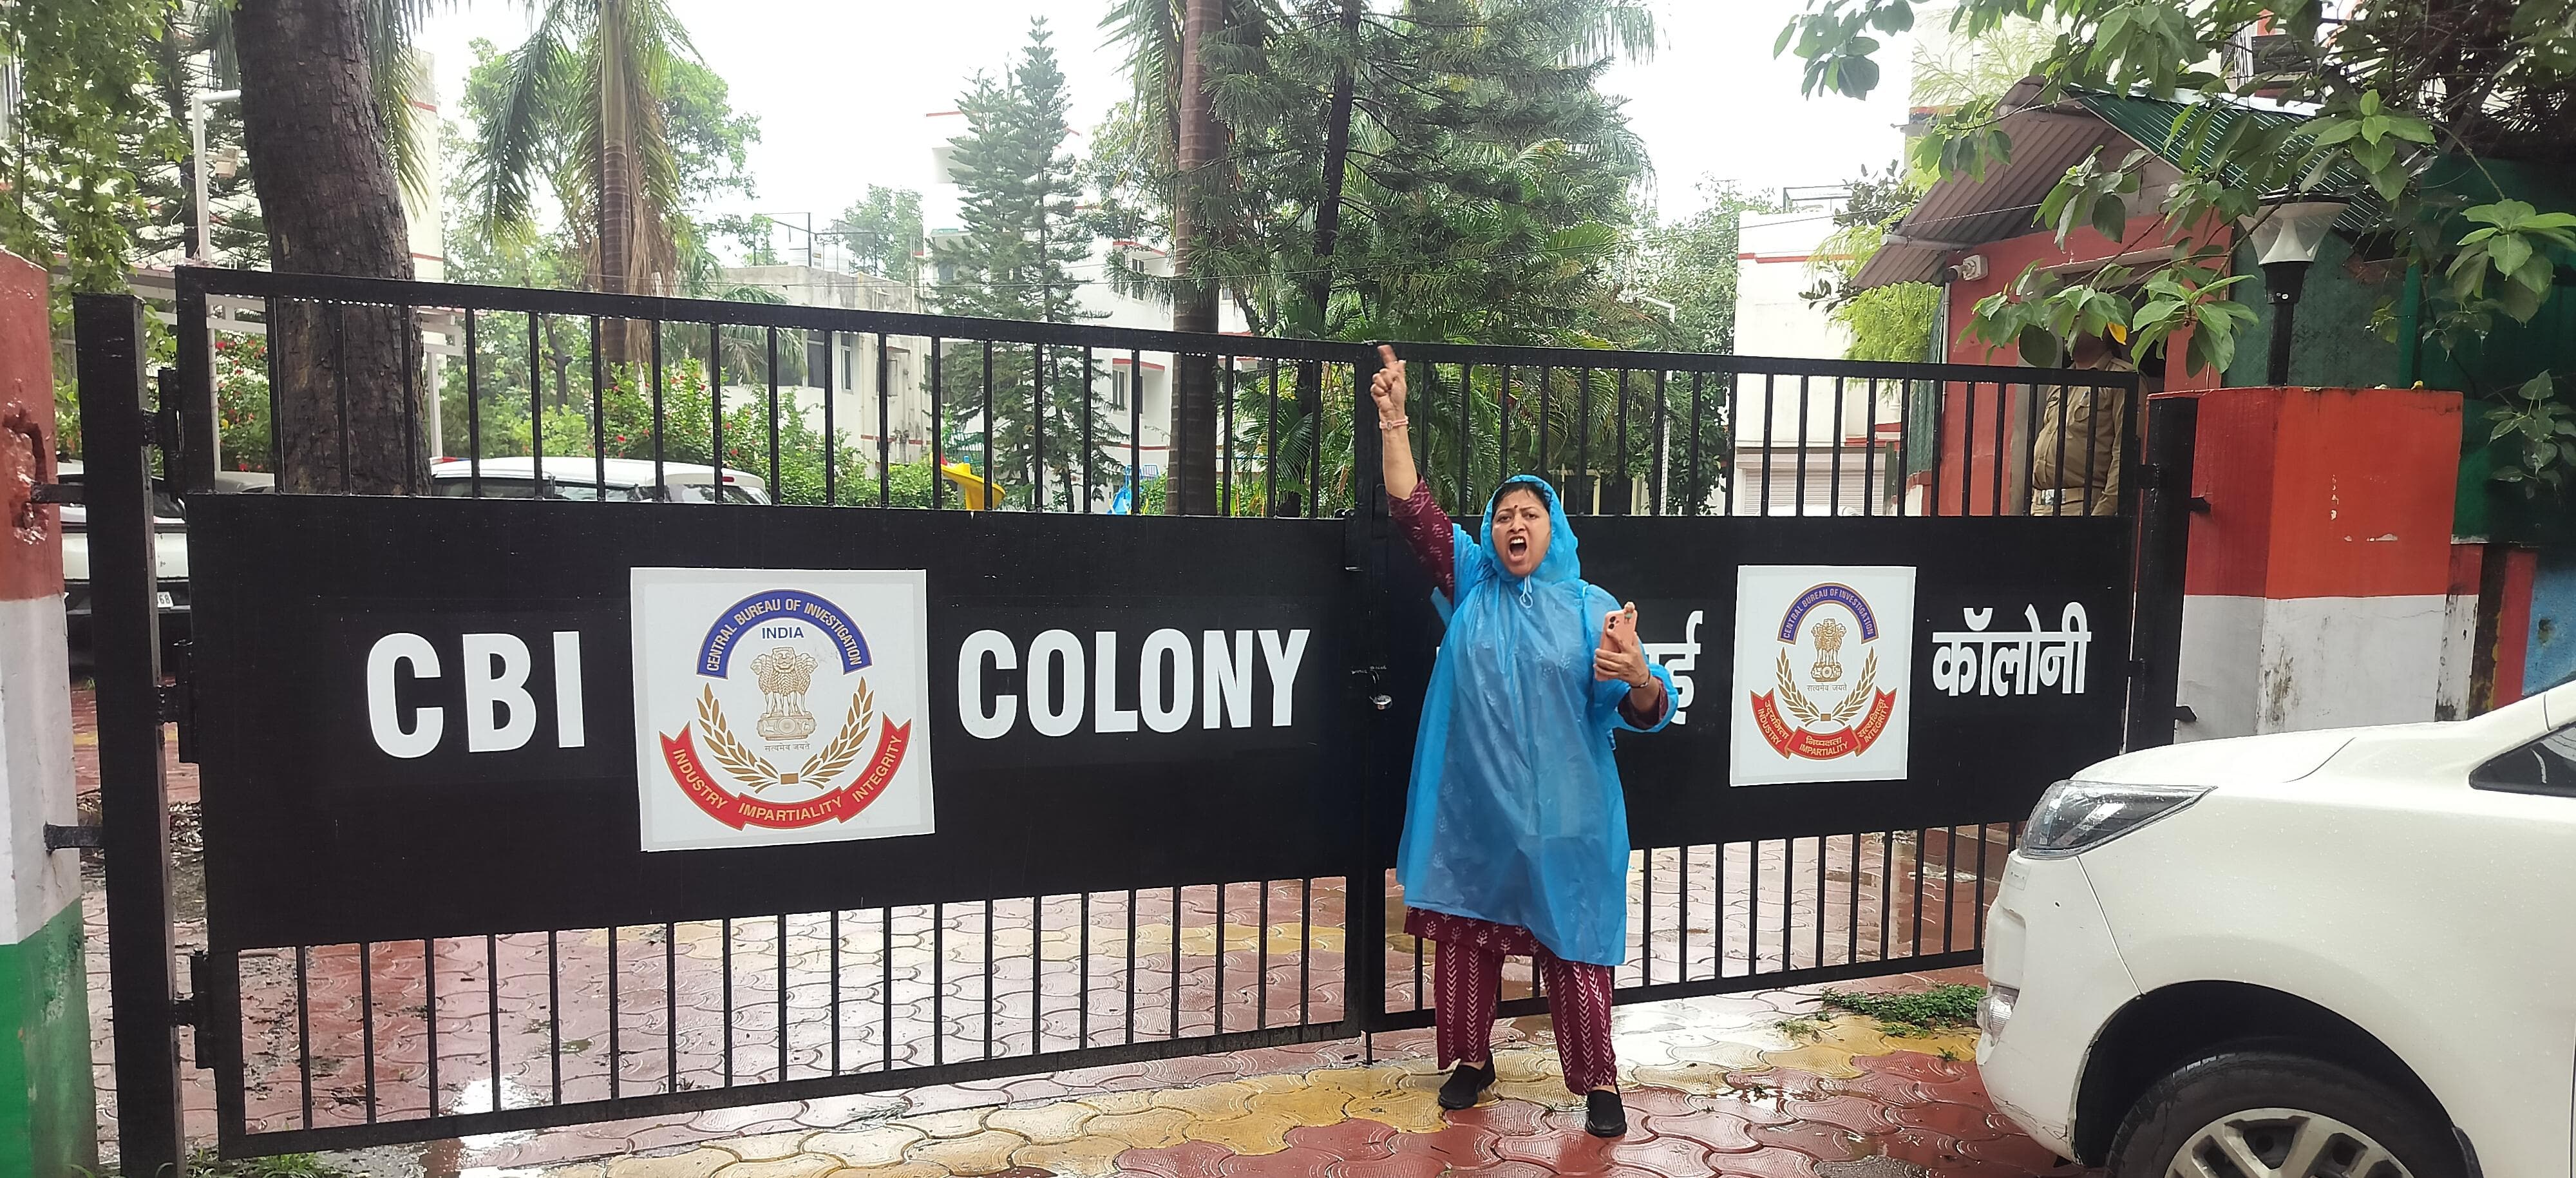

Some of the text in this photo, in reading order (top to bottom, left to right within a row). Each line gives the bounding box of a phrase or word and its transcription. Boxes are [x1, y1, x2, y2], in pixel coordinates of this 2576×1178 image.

[706, 598, 863, 672] CENTRAL BUREAU OF INVESTIGATION
[761, 627, 804, 640] INDIA
[1783, 588, 1874, 638] CENTRAL BUREAU OF INVESTIGATION
[1932, 602, 2092, 696] कॉलोनी
[367, 628, 1311, 758] CBI COLONY
[1807, 682, 1847, 691] सत्यमेव जयते
[793, 741, 811, 750] जयते
[1757, 703, 1889, 756] INDUSTRY IMPARTIALITY INTEGRITY
[672, 736, 903, 822] INDUSTRY IMPARTIALITY INTEGRITY
